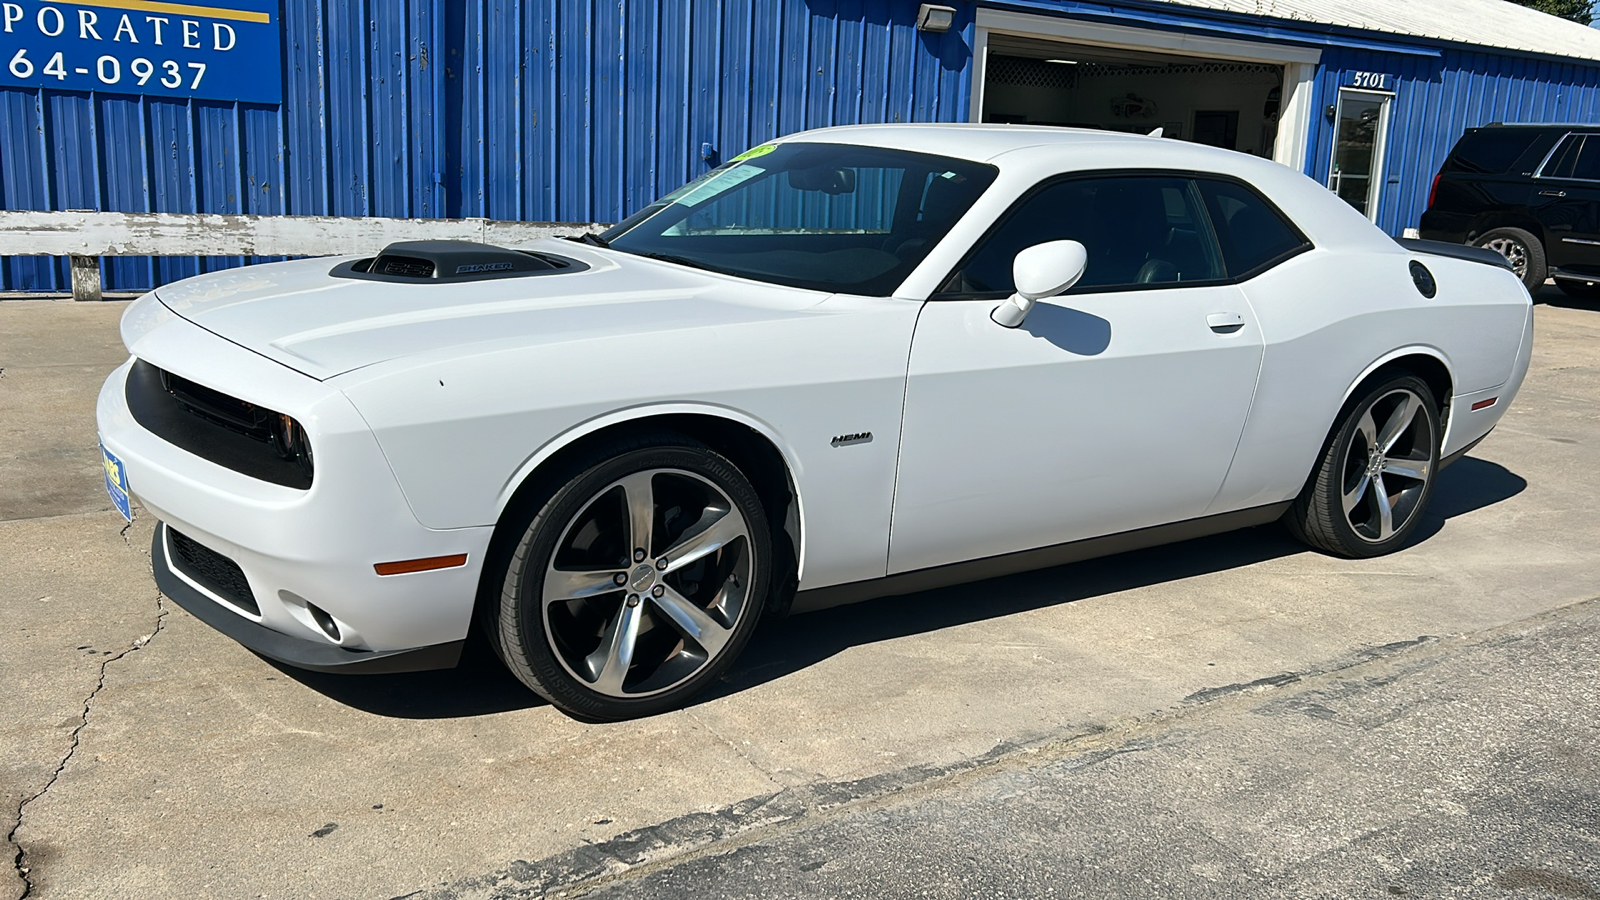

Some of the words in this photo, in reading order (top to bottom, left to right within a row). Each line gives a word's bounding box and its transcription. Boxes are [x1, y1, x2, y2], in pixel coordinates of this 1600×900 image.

[2, 3, 237, 51] PORATED
[8, 48, 207, 90] 64-0937
[1353, 71, 1385, 89] 5701
[456, 261, 513, 274] SHAKER
[830, 431, 873, 446] HEMI
